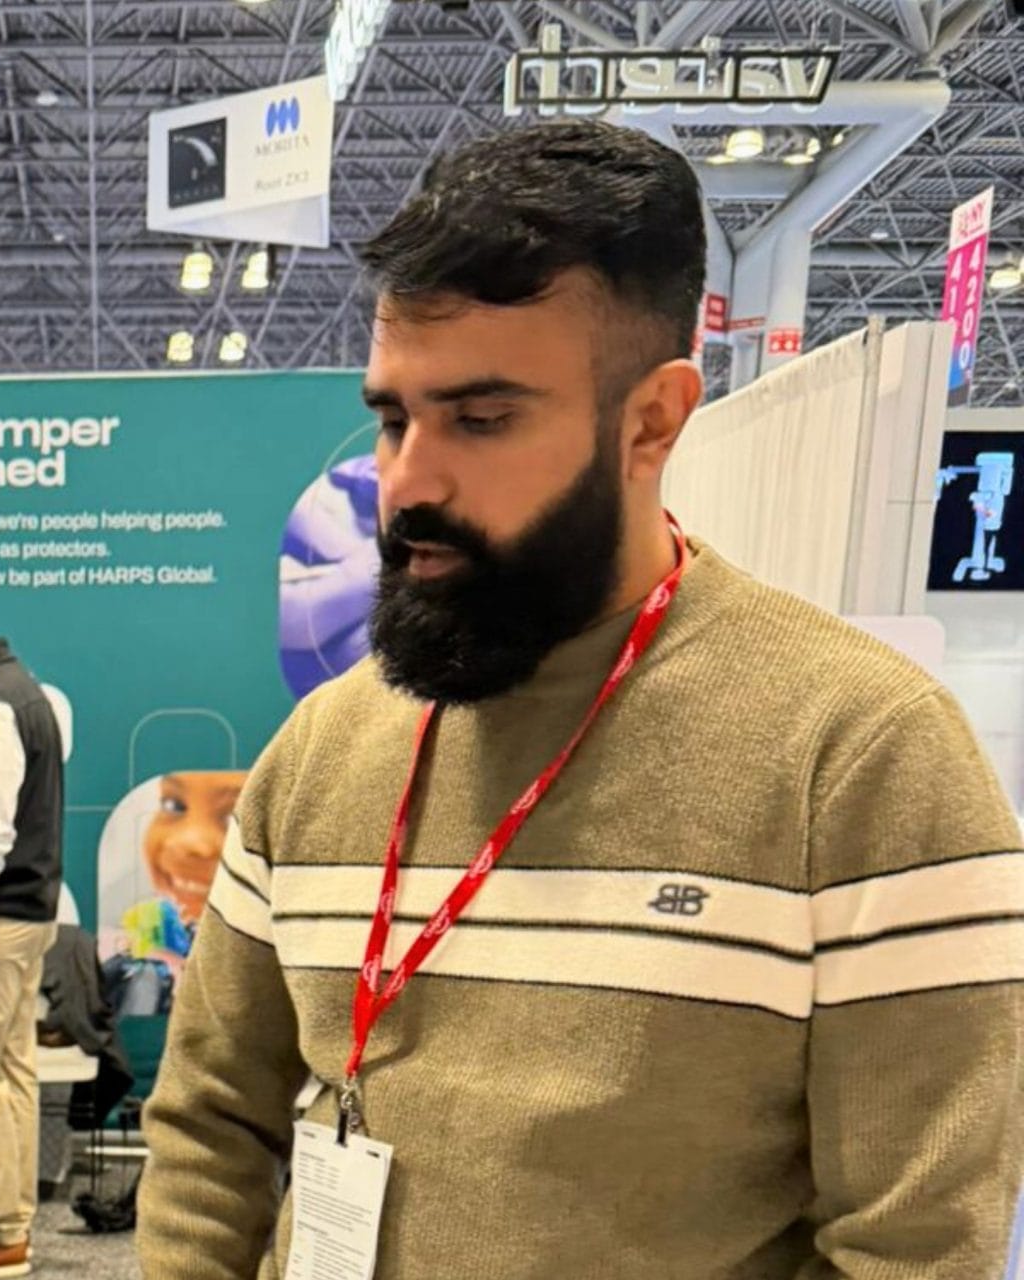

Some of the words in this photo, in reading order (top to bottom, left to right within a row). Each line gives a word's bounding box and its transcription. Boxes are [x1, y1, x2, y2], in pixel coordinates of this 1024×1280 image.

[41, 512, 98, 533] people
[101, 511, 163, 533] helping
[165, 510, 226, 531] people.
[0, 544, 20, 558] as
[23, 540, 111, 560] protectors.
[9, 568, 29, 586] be
[34, 569, 65, 588] part
[69, 567, 85, 585] of
[89, 566, 154, 585] HARPS
[157, 564, 217, 585] Global.
